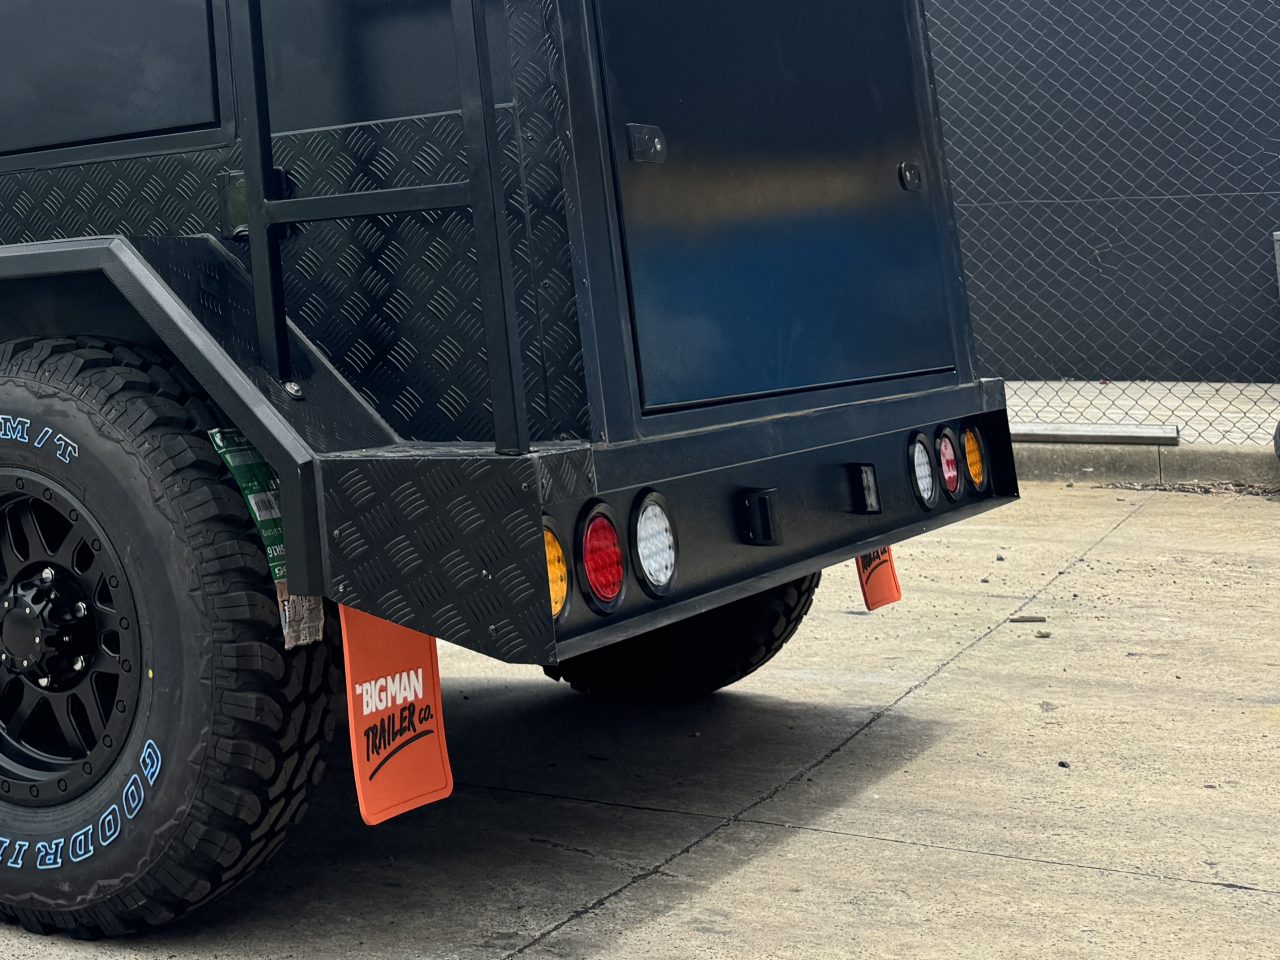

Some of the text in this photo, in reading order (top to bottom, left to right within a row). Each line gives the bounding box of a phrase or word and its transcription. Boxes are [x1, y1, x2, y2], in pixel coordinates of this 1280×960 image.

[0, 414, 80, 465] M/T
[362, 668, 423, 716] BIGMAN
[364, 703, 417, 762] TRAILER
